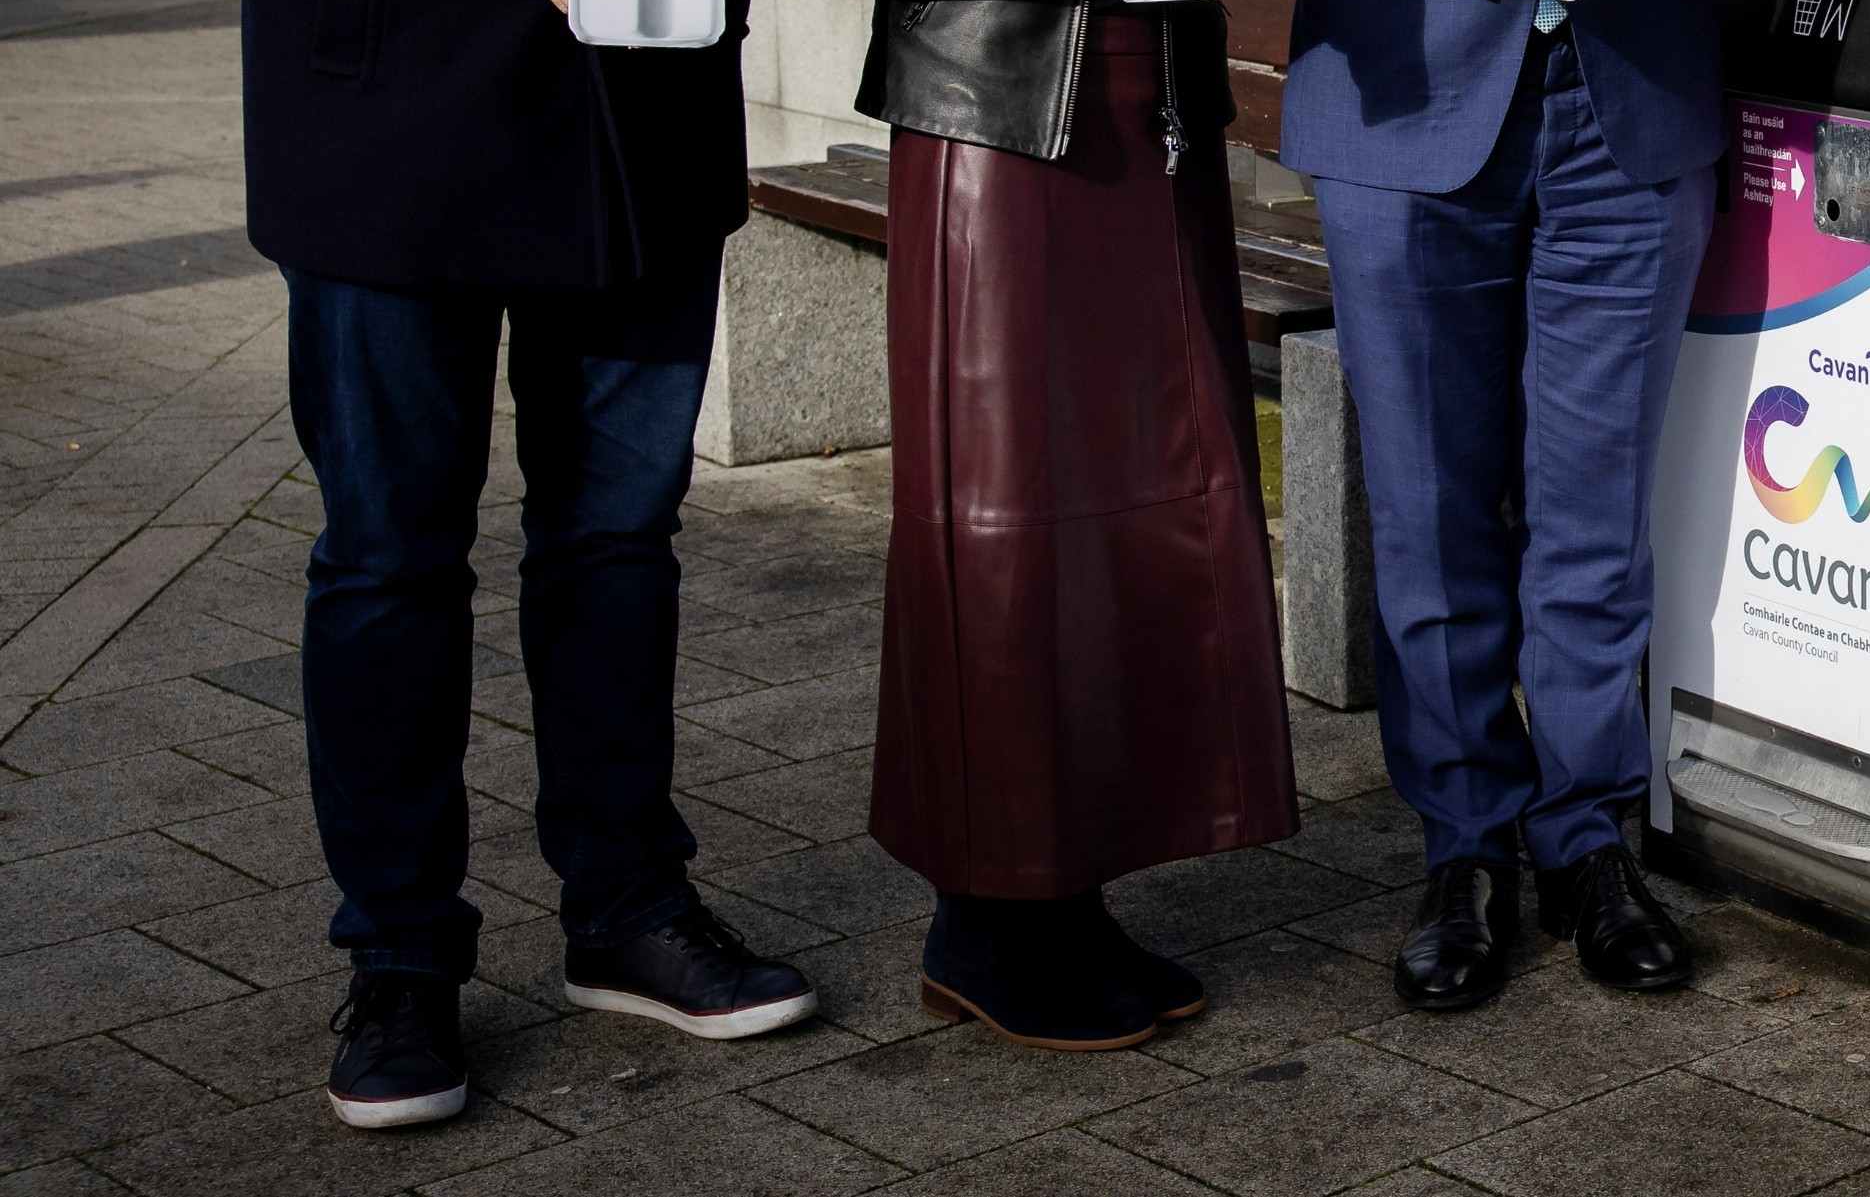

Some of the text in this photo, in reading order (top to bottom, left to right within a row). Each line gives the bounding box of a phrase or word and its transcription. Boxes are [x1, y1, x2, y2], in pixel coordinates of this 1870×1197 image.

[1742, 111, 1761, 125] Bain
[1743, 172, 1787, 191] Please Use
[1743, 187, 1774, 207] Ashtray
[1743, 602, 1790, 627] Comhairle
[1791, 617, 1825, 638] Contae
[1826, 630, 1839, 643] an
[1743, 622, 1839, 663] Cavan County Council
